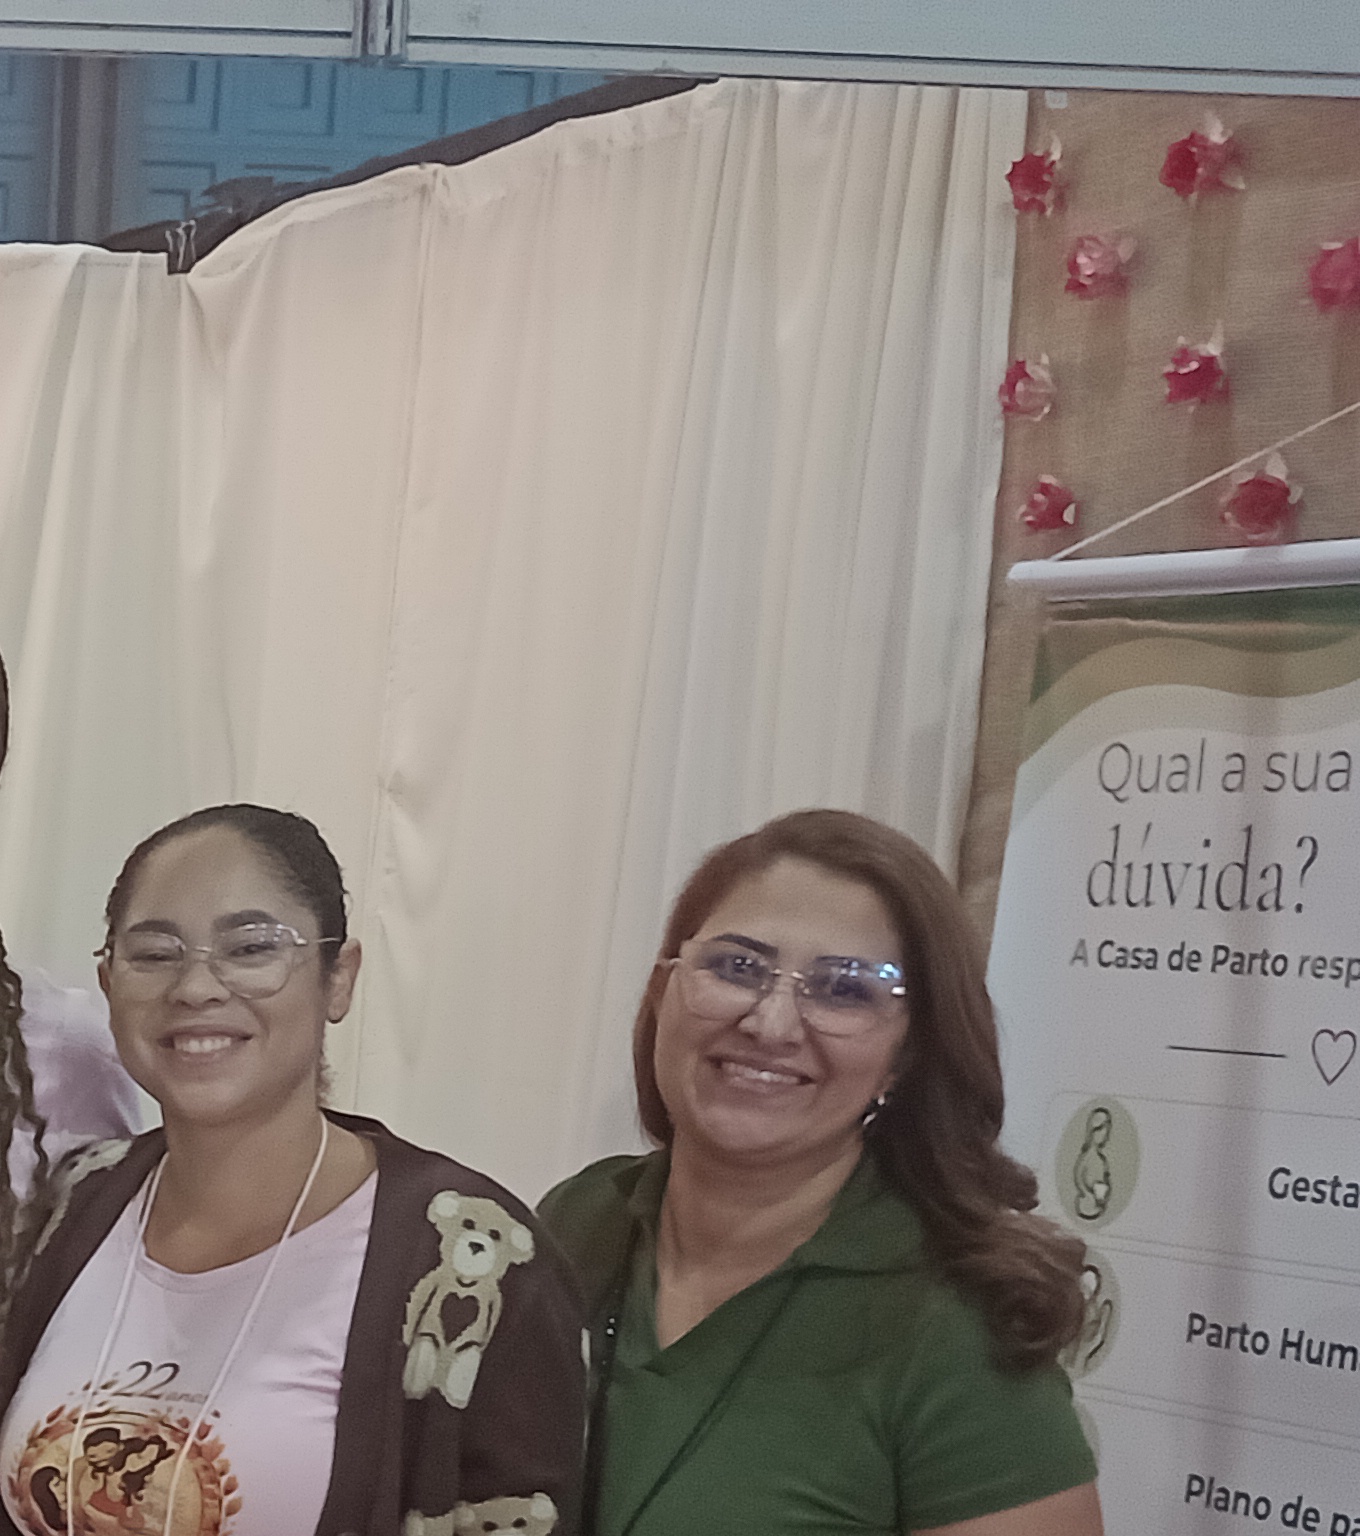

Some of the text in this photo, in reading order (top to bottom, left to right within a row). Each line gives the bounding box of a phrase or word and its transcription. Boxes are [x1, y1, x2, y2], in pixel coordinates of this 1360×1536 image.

[1098, 738, 1352, 803] Qual a sua
[1086, 822, 1319, 914] dúvida?
[1070, 938, 1088, 967] A
[1097, 940, 1159, 971] Casa
[1167, 942, 1203, 972] de
[1211, 944, 1289, 978] Parto
[1268, 1166, 1359, 1209] Gesta
[1186, 1312, 1270, 1356] Parto
[111, 1361, 180, 1399] 22
[1185, 1474, 1271, 1521] Plano
[1281, 1495, 1320, 1533] de
